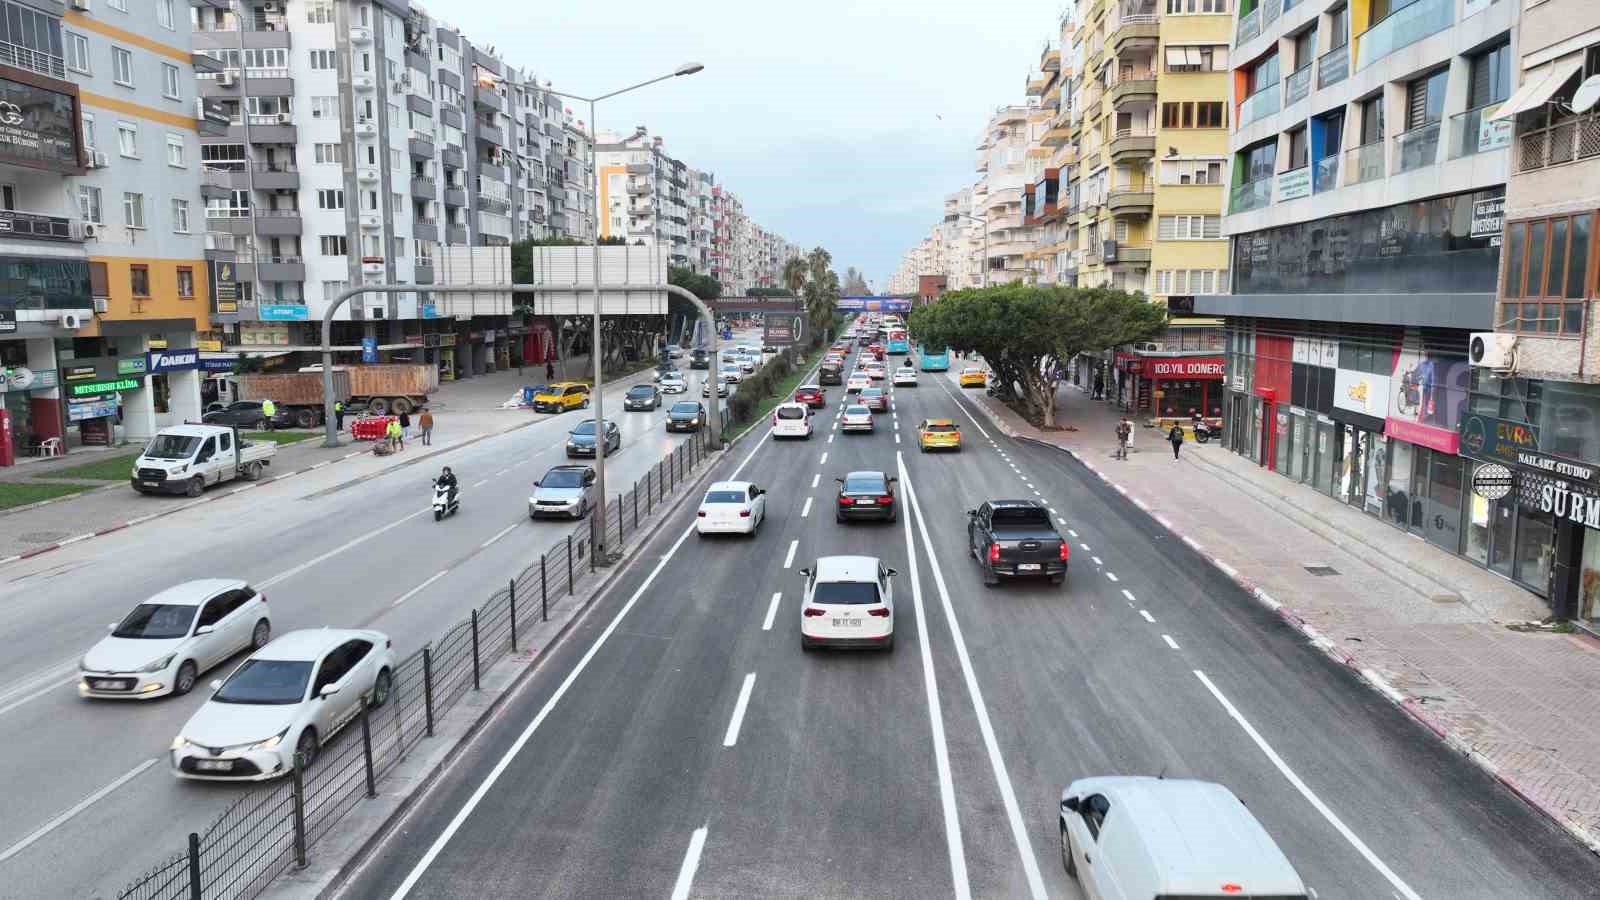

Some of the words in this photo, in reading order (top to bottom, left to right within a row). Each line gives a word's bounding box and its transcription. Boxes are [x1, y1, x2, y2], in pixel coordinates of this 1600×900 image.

[160, 354, 196, 366] DAIKIN
[116, 379, 138, 390] KLİMA
[1518, 453, 1537, 465] NAIL
[1556, 462, 1591, 480] STUDIO
